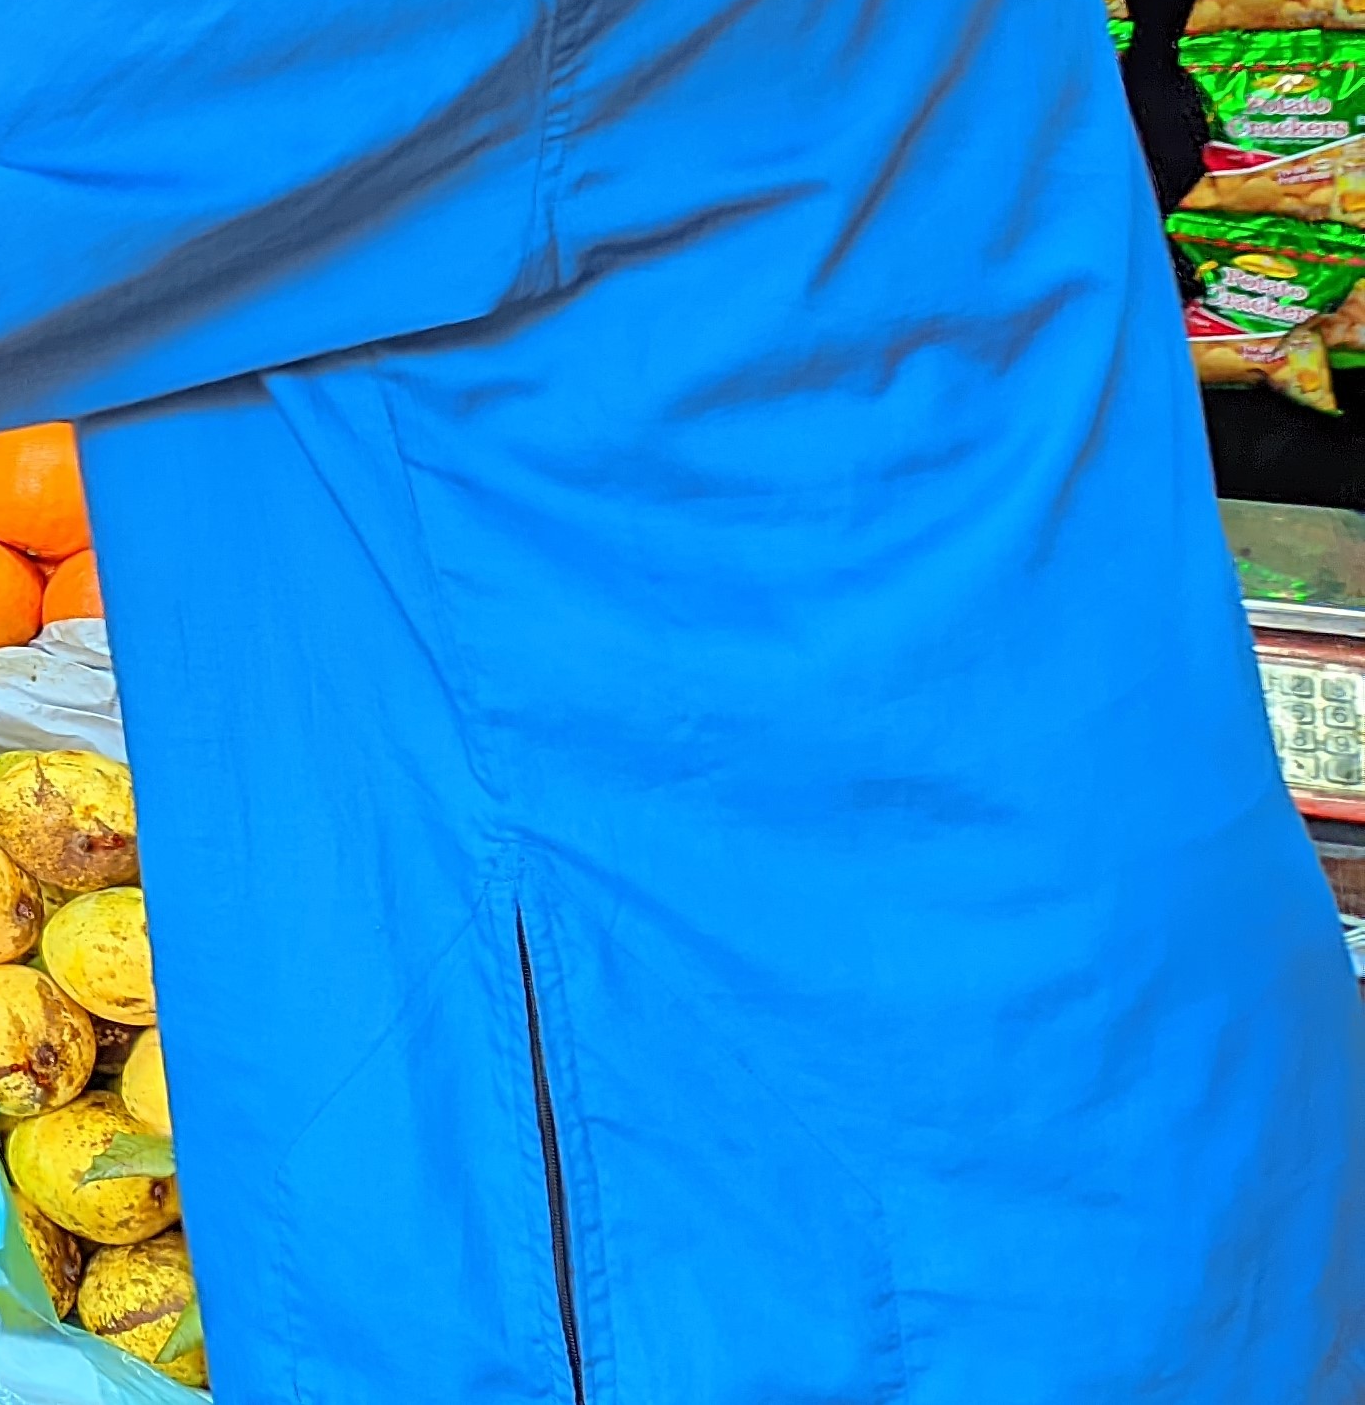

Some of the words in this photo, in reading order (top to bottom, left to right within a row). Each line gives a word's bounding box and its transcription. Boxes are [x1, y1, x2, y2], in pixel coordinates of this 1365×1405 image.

[1243, 92, 1333, 116] Potato
[1224, 115, 1351, 140] Crackers
[1220, 265, 1310, 301] Potato
[1332, 706, 1347, 724] 6
[1293, 728, 1308, 747] 8
